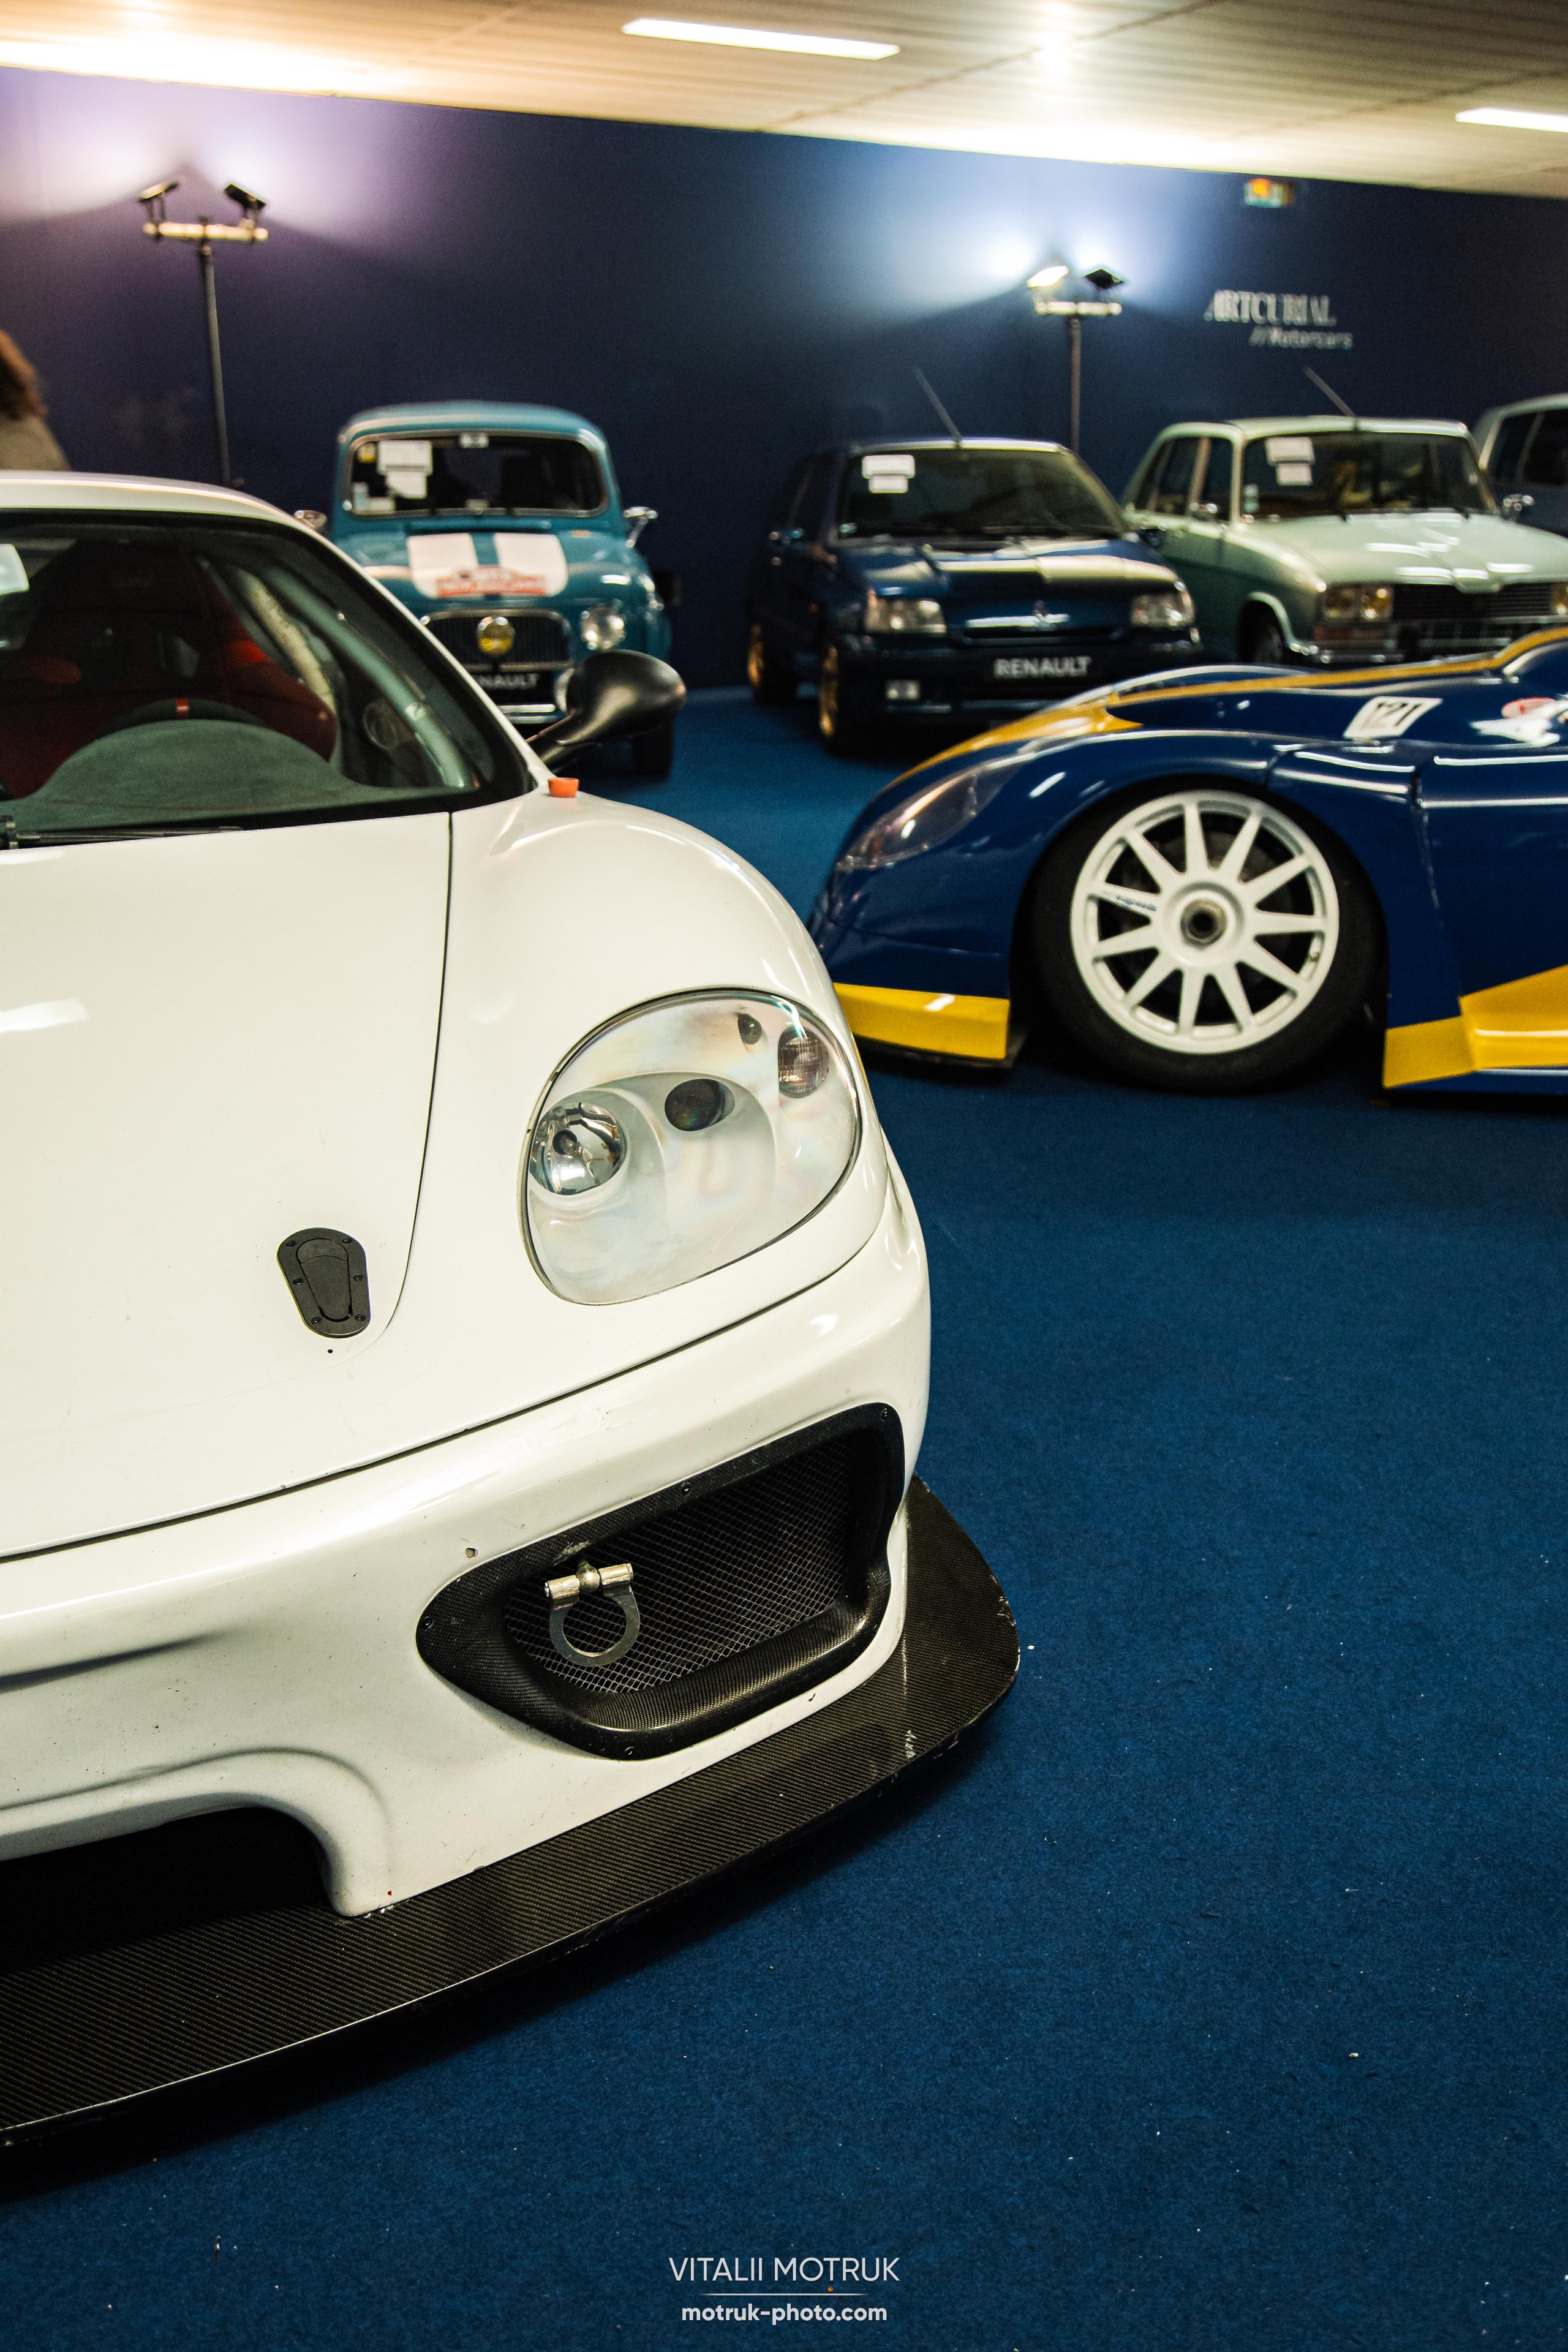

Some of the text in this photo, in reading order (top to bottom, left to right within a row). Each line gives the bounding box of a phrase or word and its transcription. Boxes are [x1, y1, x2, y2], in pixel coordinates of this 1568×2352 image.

[993, 656, 1091, 678] RENAULT
[473, 673, 540, 690] NAULT
[1361, 702, 1422, 729] 121
